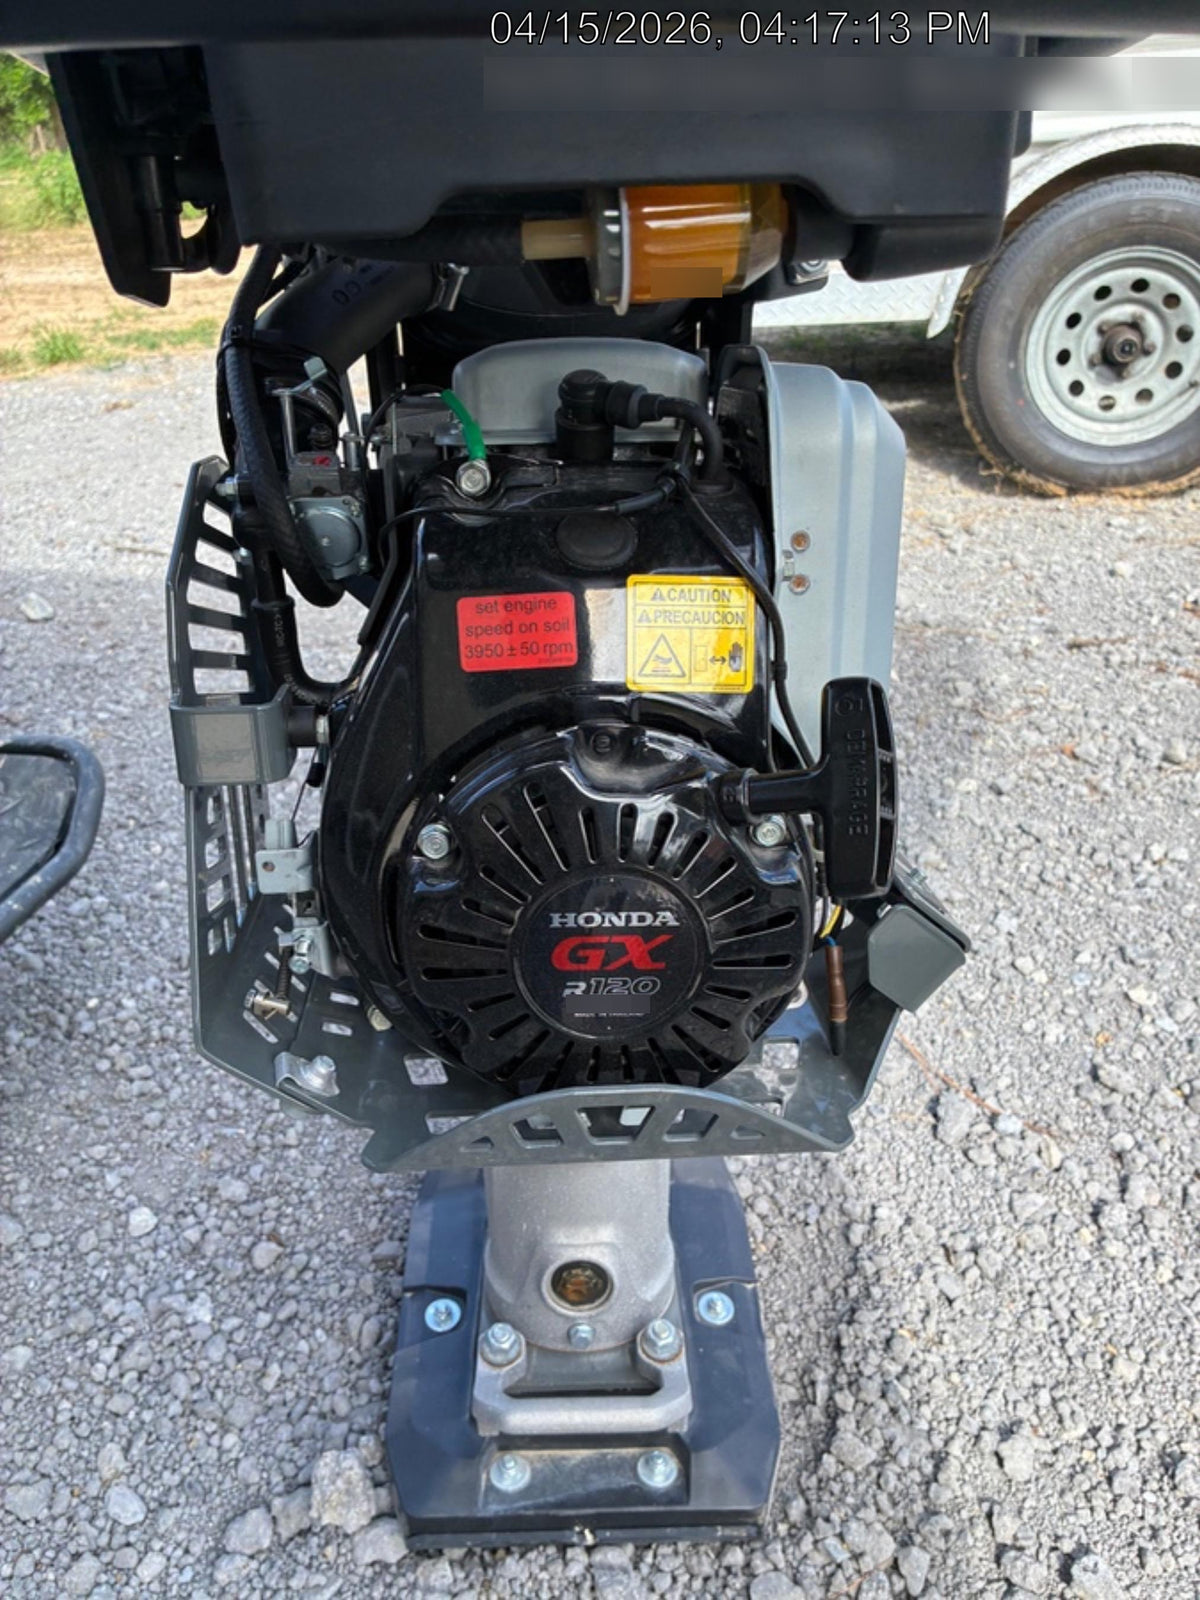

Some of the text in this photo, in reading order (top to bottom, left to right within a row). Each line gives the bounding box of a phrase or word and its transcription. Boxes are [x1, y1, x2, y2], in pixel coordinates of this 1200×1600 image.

[666, 588, 732, 602] CAUTION
[475, 598, 557, 614] set engine
[654, 610, 744, 625] PRECAUCION
[465, 616, 569, 639] speed on soil
[464, 643, 504, 659] 3950
[543, 642, 573, 656] rpm
[549, 911, 680, 928] HONDA
[550, 934, 674, 971] GX
